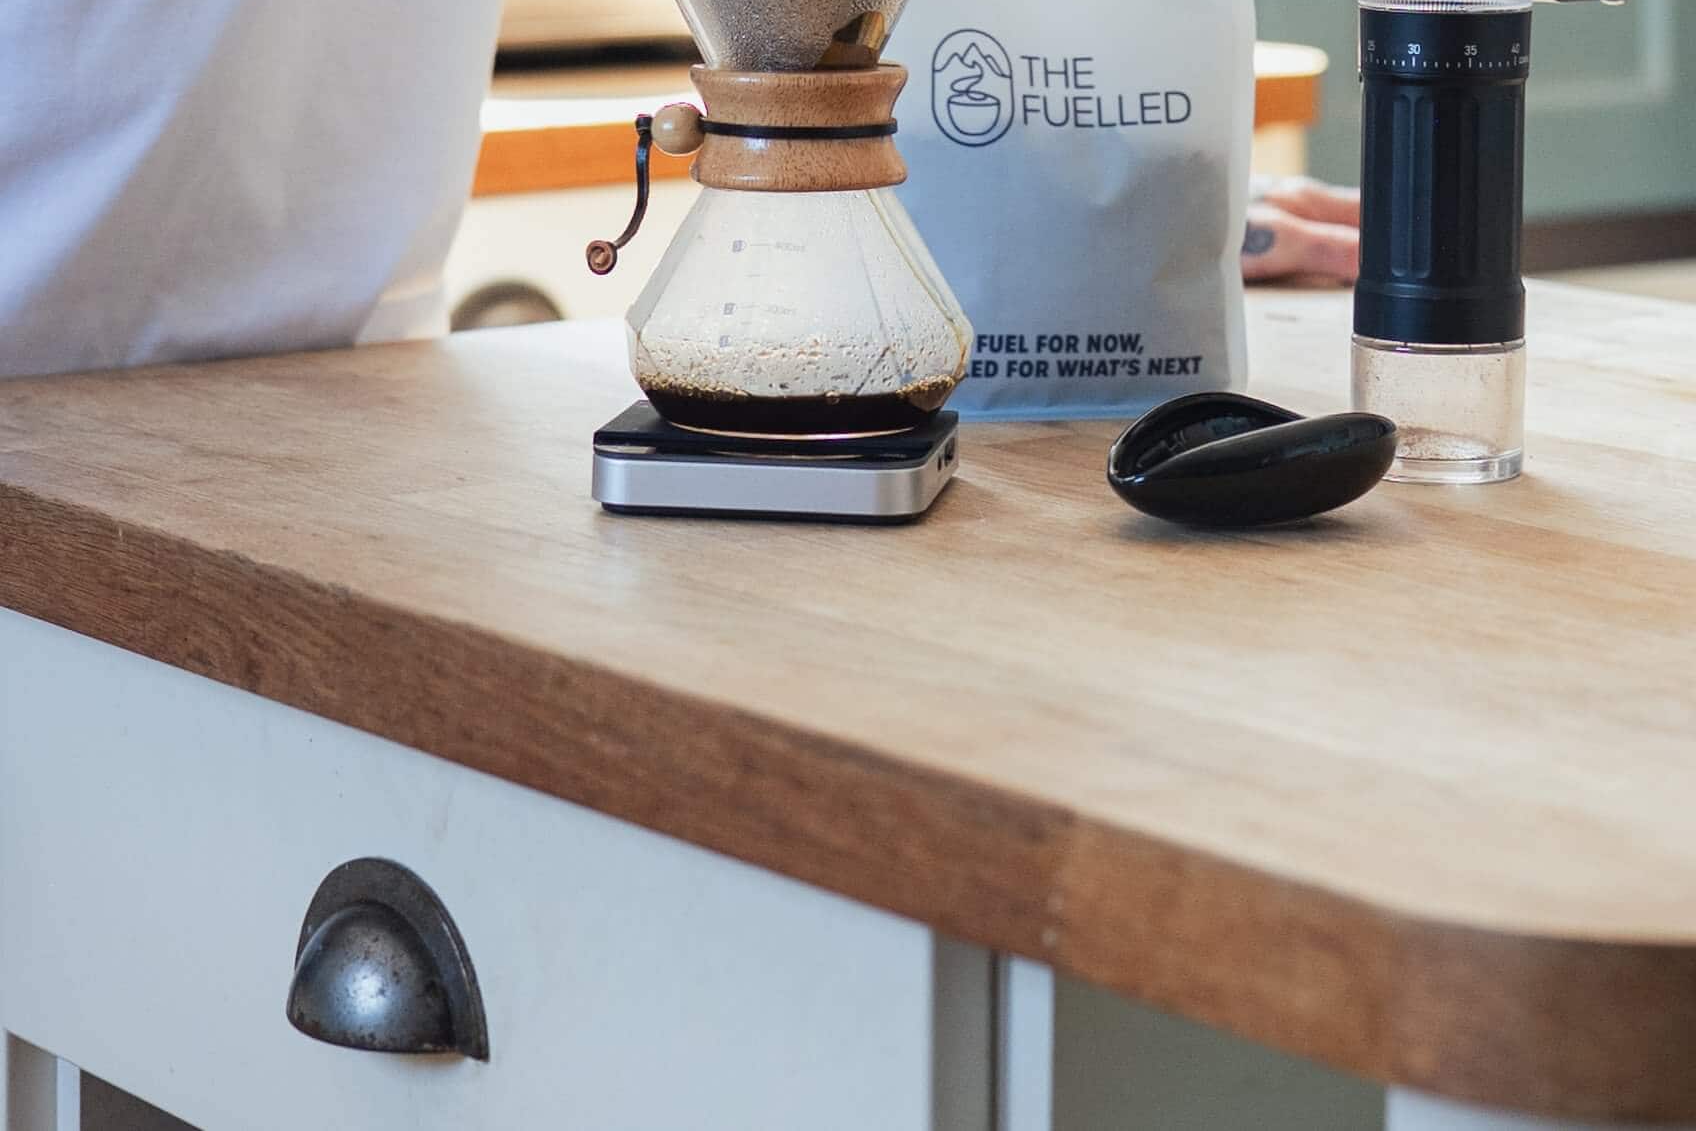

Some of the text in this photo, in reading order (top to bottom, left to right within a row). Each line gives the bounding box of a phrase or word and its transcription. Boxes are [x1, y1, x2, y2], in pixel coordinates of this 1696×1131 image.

[1407, 43, 1421, 55] 30
[1464, 45, 1478, 56] 35
[1020, 55, 1095, 89] THE
[1022, 91, 1192, 128] FUELLED
[976, 333, 1145, 355] FUEL FOR NOW,
[1006, 359, 1049, 378] FOR
[1057, 357, 1141, 378] WHAT'S
[1147, 356, 1203, 375] NEXT
